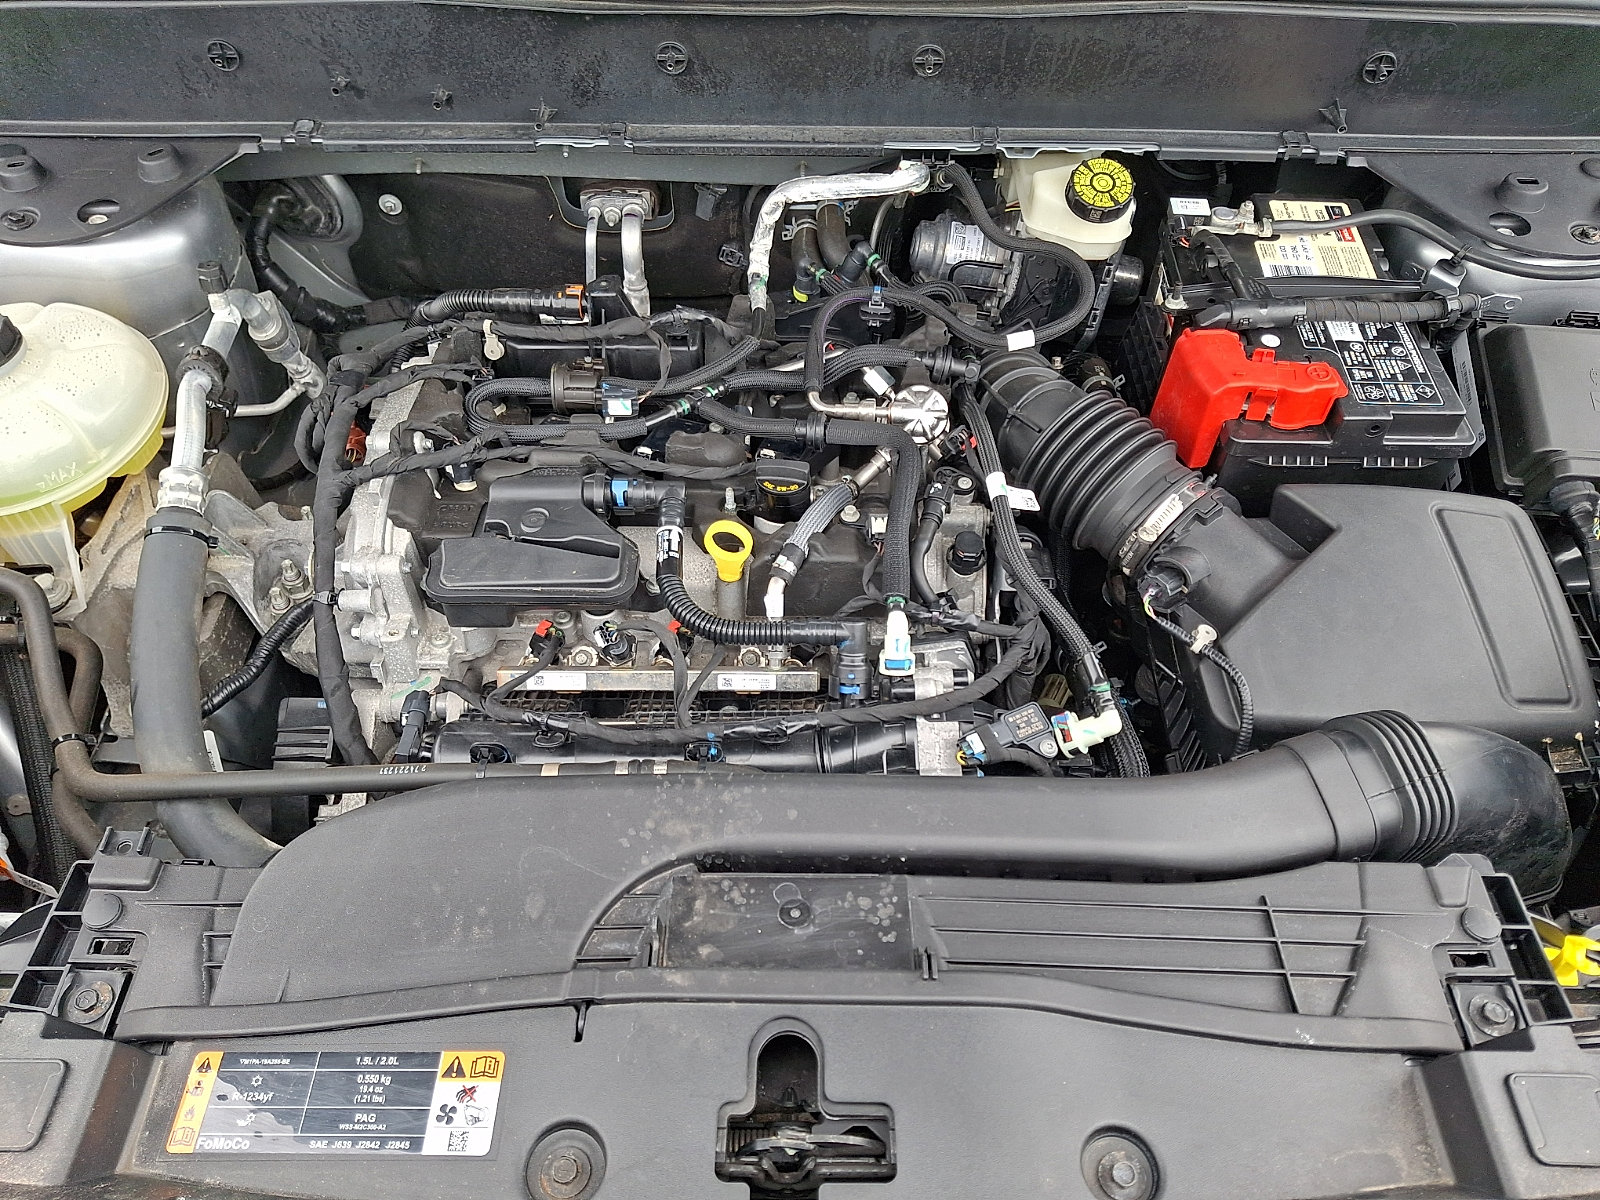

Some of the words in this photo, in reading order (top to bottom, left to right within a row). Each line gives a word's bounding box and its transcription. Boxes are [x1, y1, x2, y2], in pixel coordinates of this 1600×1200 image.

[43, 461, 83, 486] MAX
[356, 1056, 374, 1065] 1.5L
[380, 1056, 400, 1065] 2.0L
[357, 1074, 380, 1084] 0.550
[381, 1074, 392, 1086] kg
[360, 1085, 374, 1093] 19.4
[232, 1092, 275, 1104] R-1234yf
[353, 1095, 371, 1104] (1.21
[354, 1113, 377, 1123] PAG
[196, 1137, 250, 1150] FoMoCo
[309, 1140, 328, 1149] SAE
[331, 1141, 352, 1149] J639
[355, 1141, 380, 1149] J2842
[385, 1141, 411, 1150] J2845
